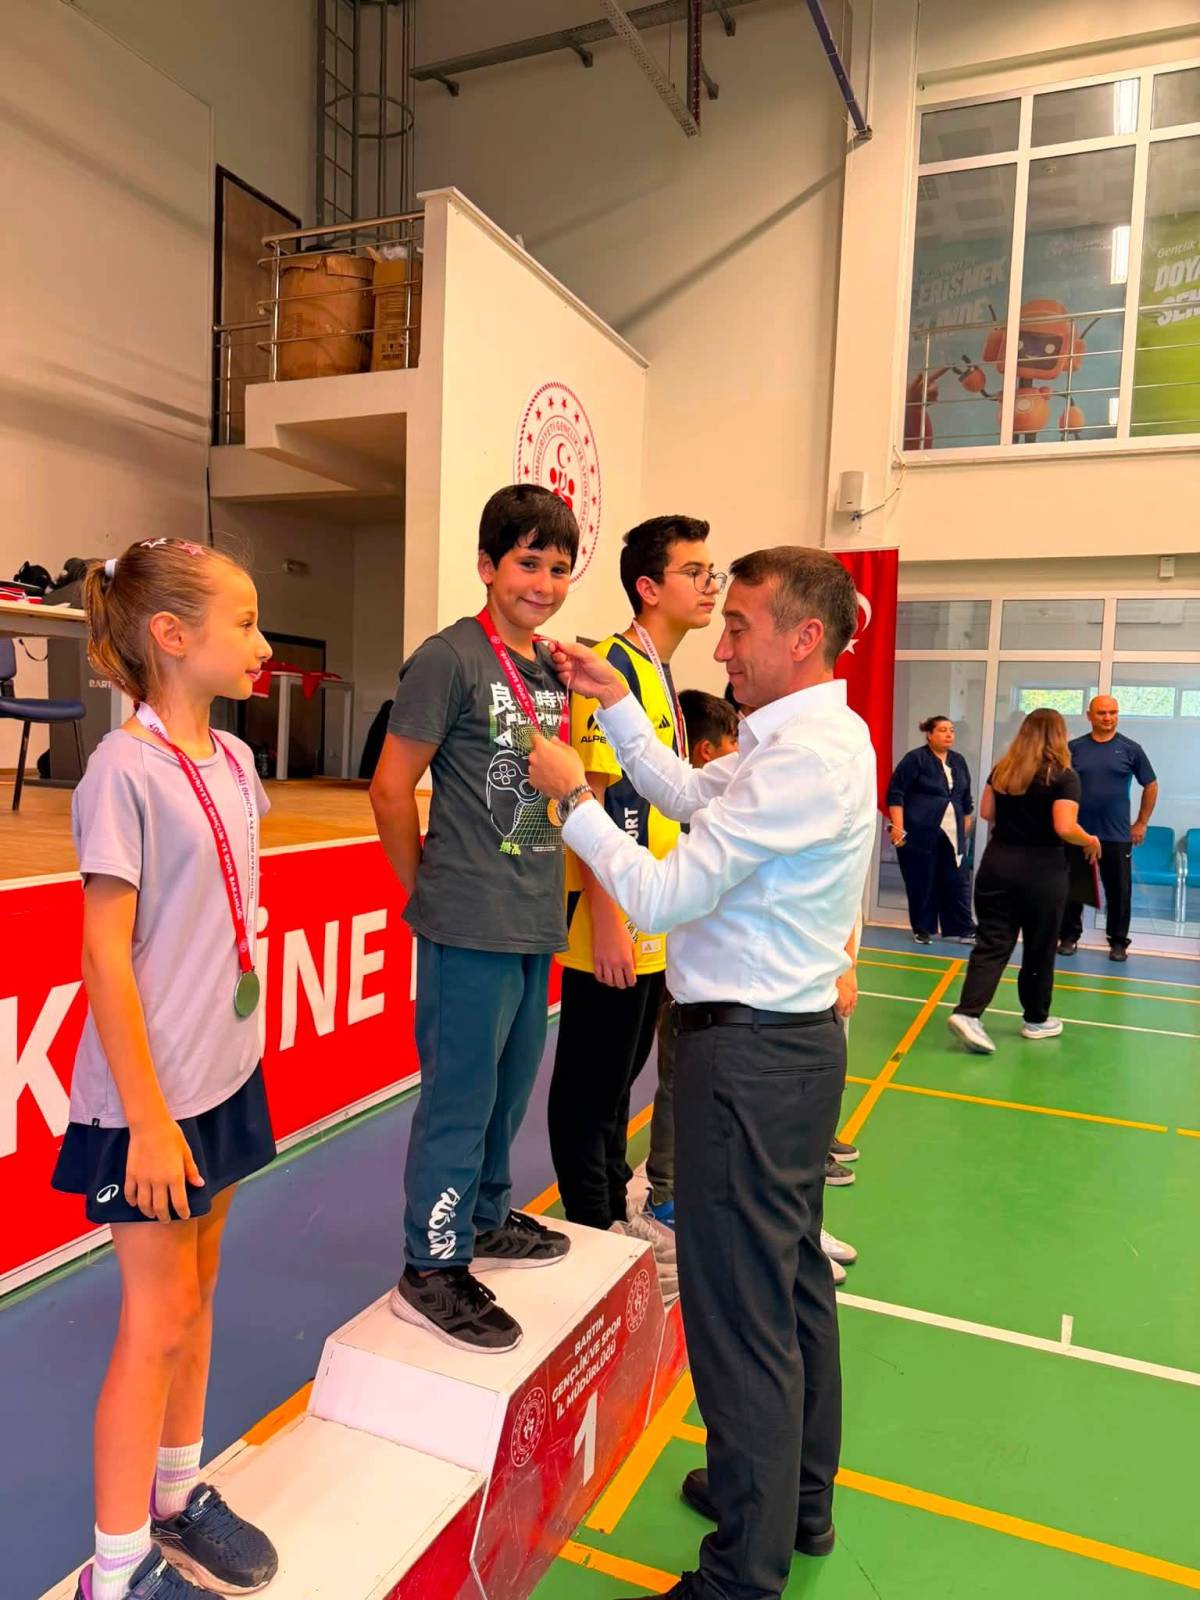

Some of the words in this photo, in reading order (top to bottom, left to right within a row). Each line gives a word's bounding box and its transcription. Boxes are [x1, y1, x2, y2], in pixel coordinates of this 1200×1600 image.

[89, 679, 112, 688] BART
[580, 734, 607, 744] ALPE
[257, 906, 387, 1059] İNE
[552, 1353, 590, 1402] GENÇLİK
[590, 1339, 601, 1358] VE
[601, 1315, 621, 1346] SPOR
[574, 1314, 604, 1356] BARTIN
[573, 1389, 598, 1487] 1
